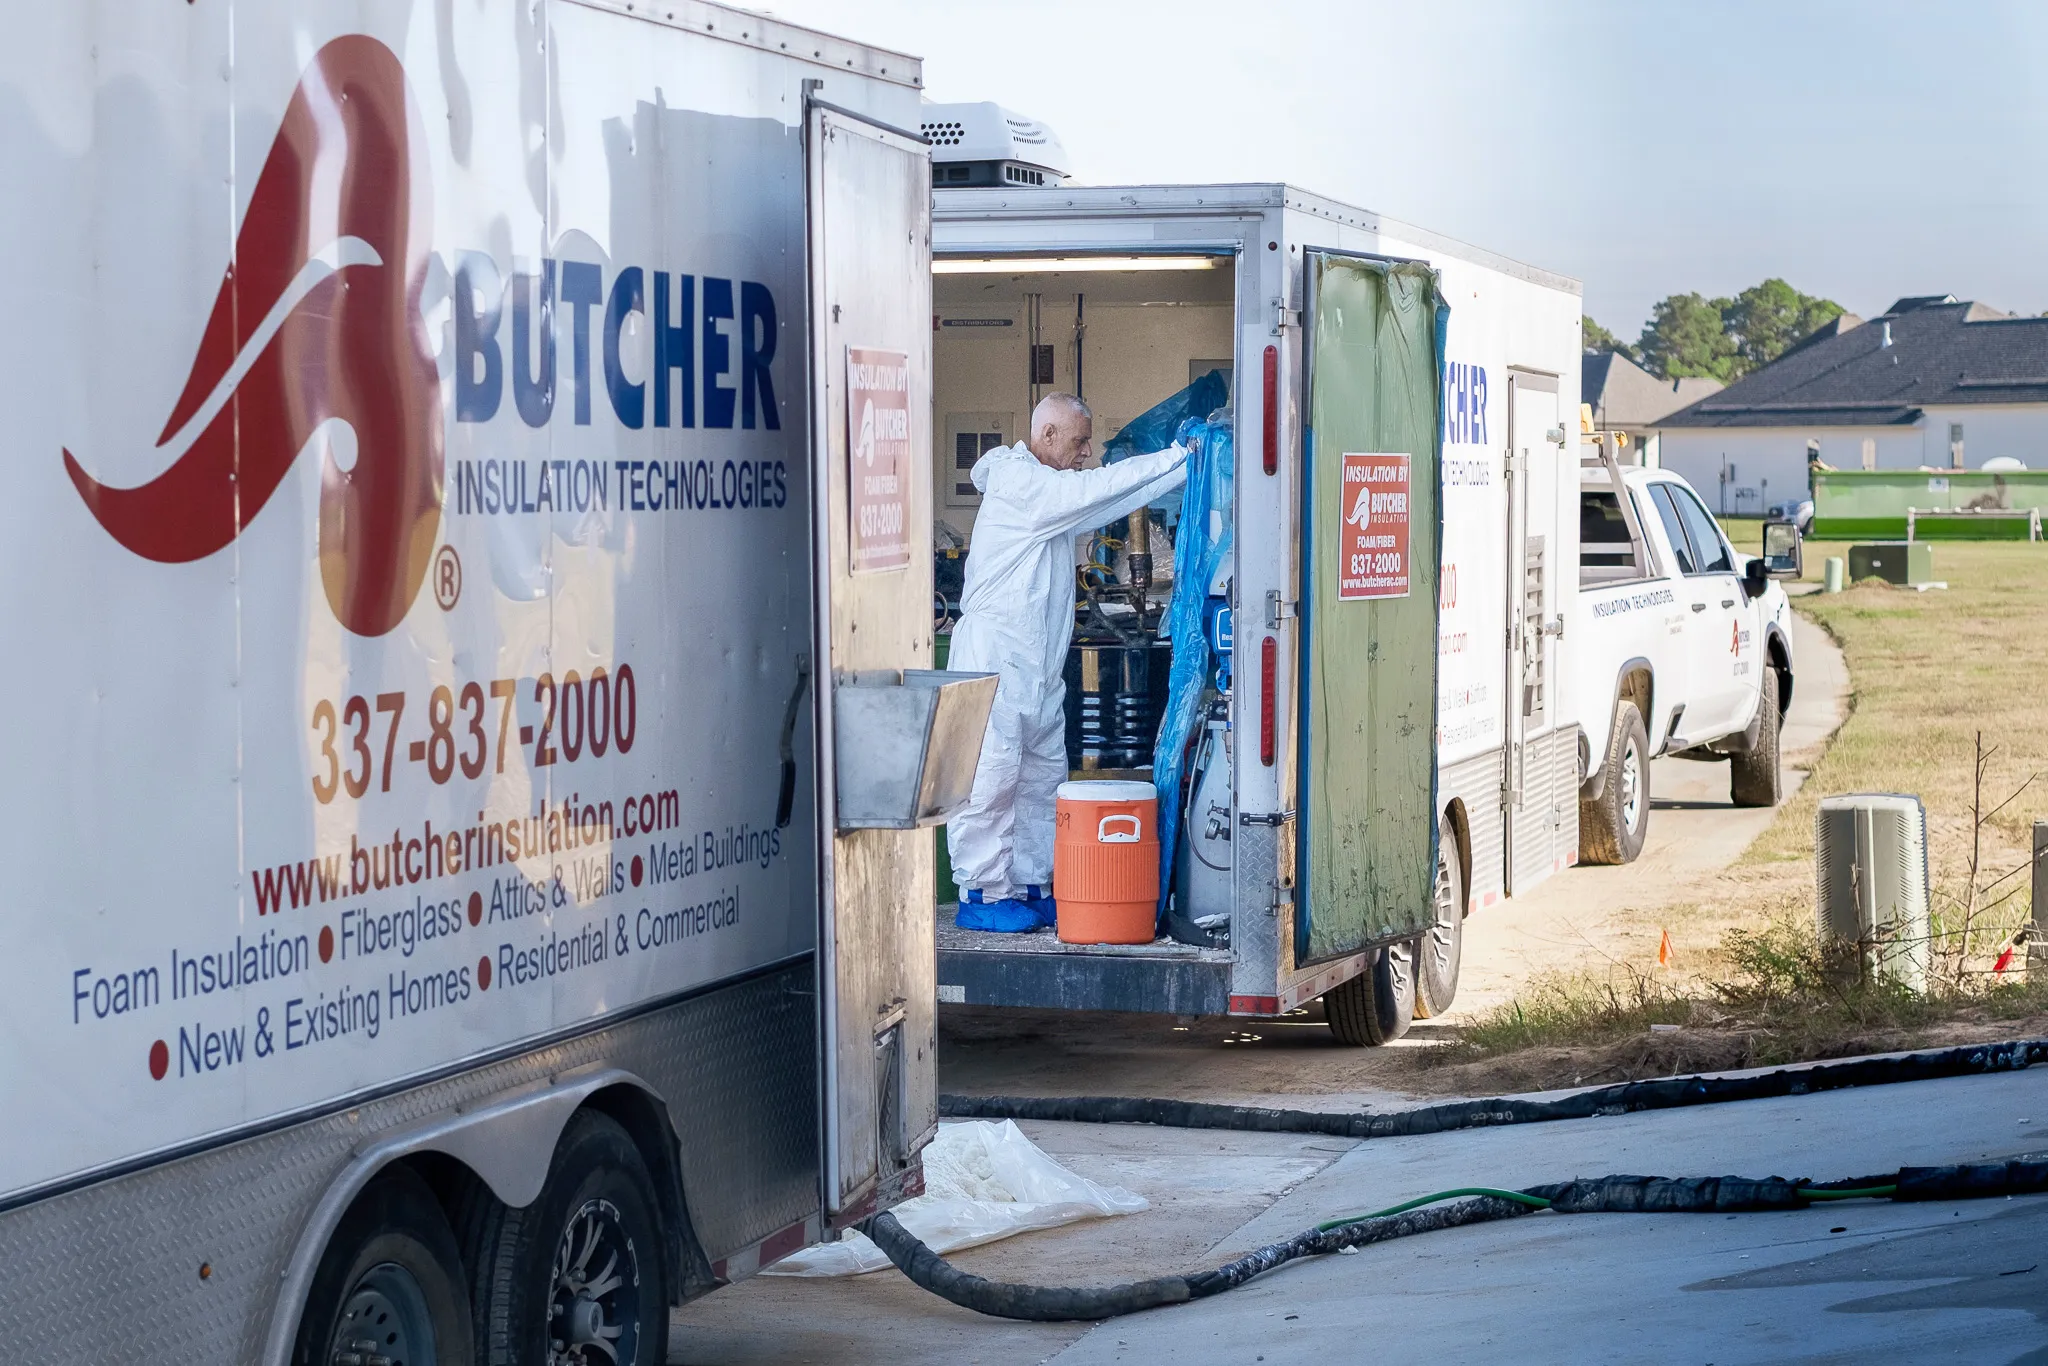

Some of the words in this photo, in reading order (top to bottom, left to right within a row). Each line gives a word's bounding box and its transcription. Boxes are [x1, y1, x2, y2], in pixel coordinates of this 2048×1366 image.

[454, 249, 782, 431] BUTCHER
[851, 363, 897, 391] INSULATION
[897, 367, 908, 392] BY
[1444, 361, 1488, 445] CHER
[875, 409, 908, 440] BUTCHER
[876, 442, 909, 457] INSULATION
[457, 460, 607, 515] INSULATION
[616, 459, 788, 512] TECHNOLOGIES
[1346, 465, 1396, 483] INSULATION
[1398, 465, 1409, 482] BY
[1371, 493, 1407, 514] BUTCHER
[860, 502, 903, 538] 837-2000
[1371, 514, 1407, 523] INSULATION
[1357, 535, 1396, 549] FOAM/FIBER
[1351, 552, 1401, 575] 837-2000
[1342, 575, 1408, 589] www.butcherac.com
[1592, 597, 1632, 618] INSULATION
[1632, 589, 1675, 611] TECHNOLOGIES
[311, 663, 637, 805] 337-837-2000
[1056, 811, 1071, 831] 09
[252, 786, 681, 917] www.butcherinsulation.com
[72, 963, 160, 1026] Foam
[171, 930, 310, 1001] Insulation
[340, 893, 463, 961] Fiberglass
[487, 872, 548, 925] Attics
[551, 864, 568, 909] &
[572, 860, 626, 904] Walls
[648, 839, 699, 886] Metal
[702, 824, 781, 874] Buildings
[178, 1020, 246, 1077] New
[255, 1009, 274, 1058] &
[285, 978, 381, 1046] Existing
[387, 963, 471, 1019] Homes
[497, 928, 609, 990] Residential
[614, 923, 630, 954] &
[636, 888, 741, 949] Commercial
